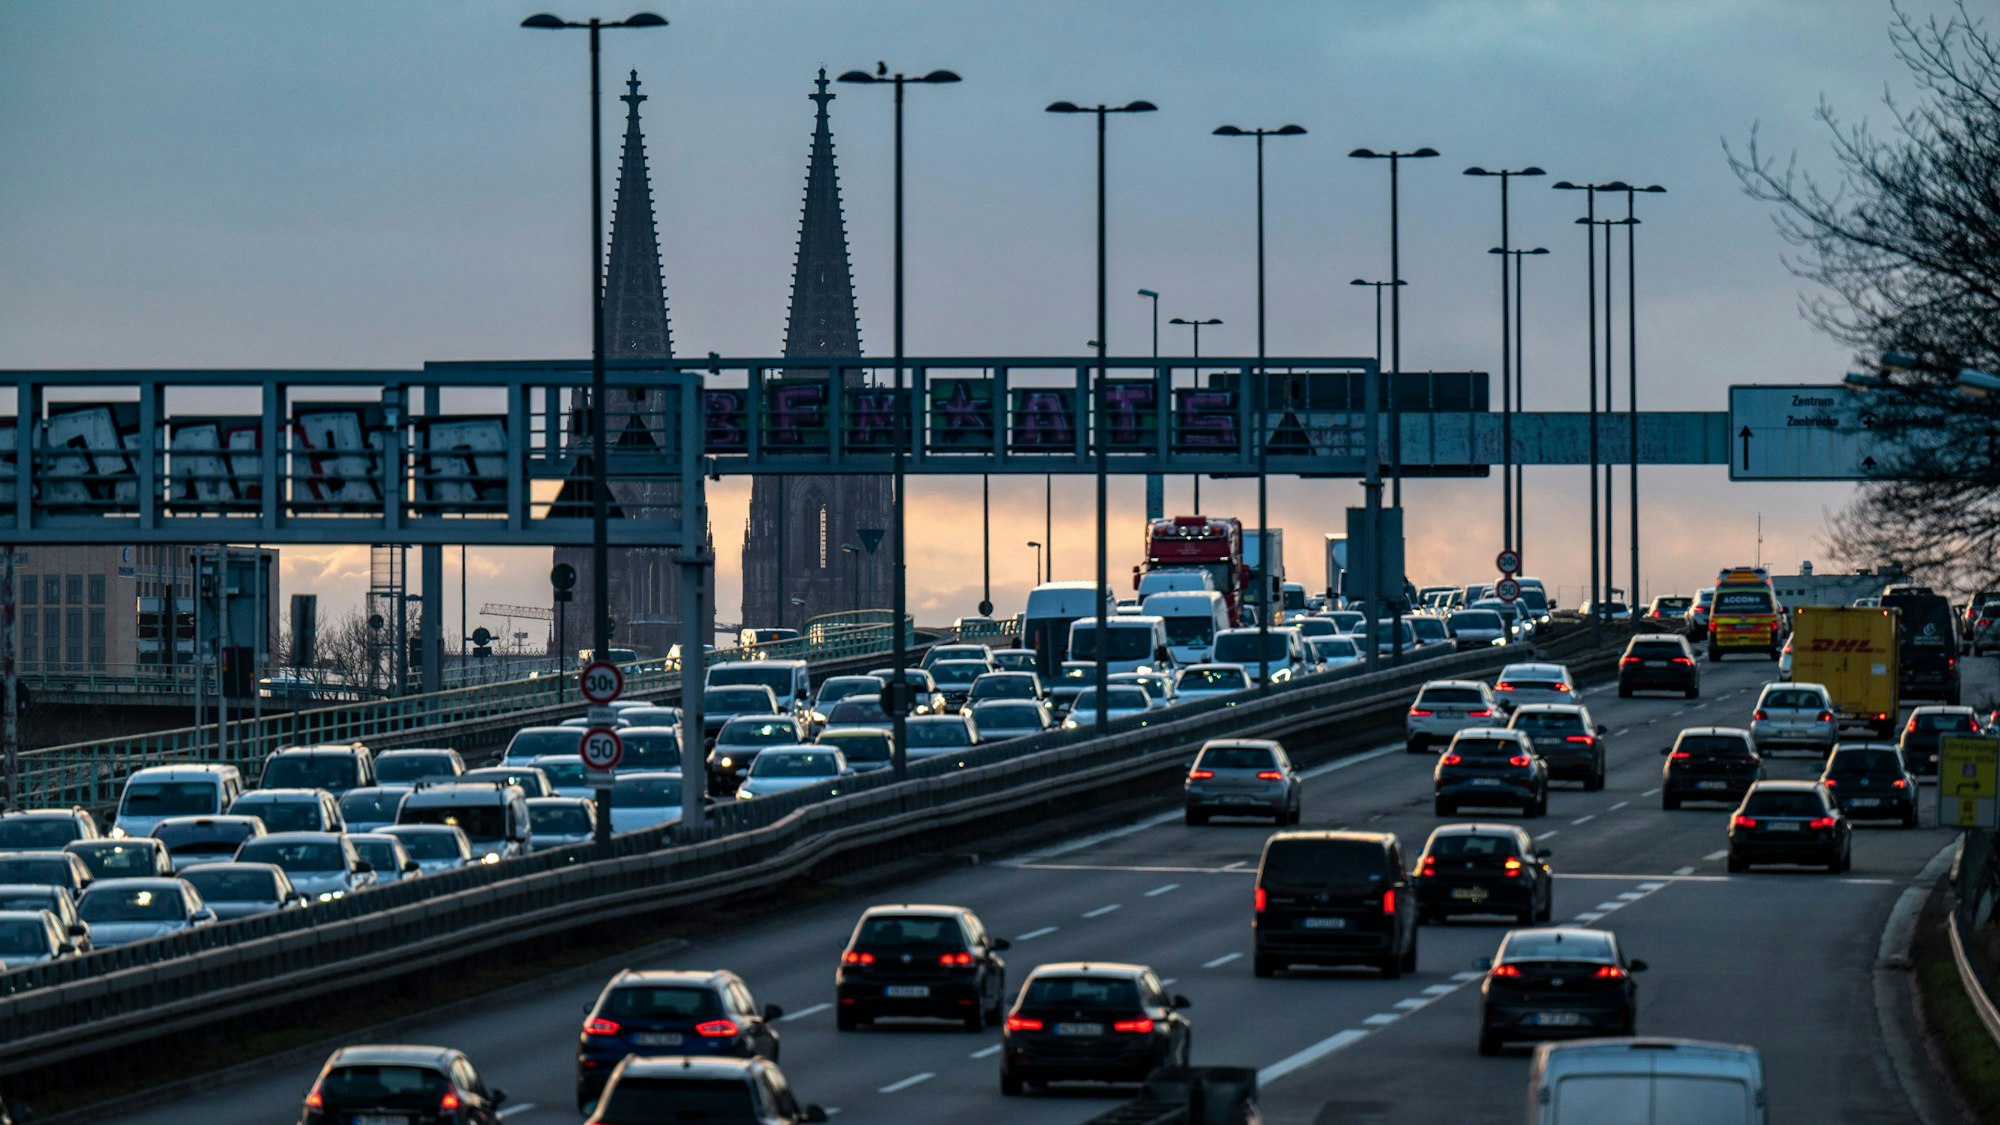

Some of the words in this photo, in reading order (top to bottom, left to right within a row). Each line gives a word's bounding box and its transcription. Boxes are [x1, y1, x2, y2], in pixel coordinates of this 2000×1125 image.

[1792, 395, 1834, 406] Zentrum
[1501, 584, 1515, 596] 50
[1811, 638, 1872, 653] DHL
[588, 675, 613, 691] 30t
[590, 739, 613, 759] 50
